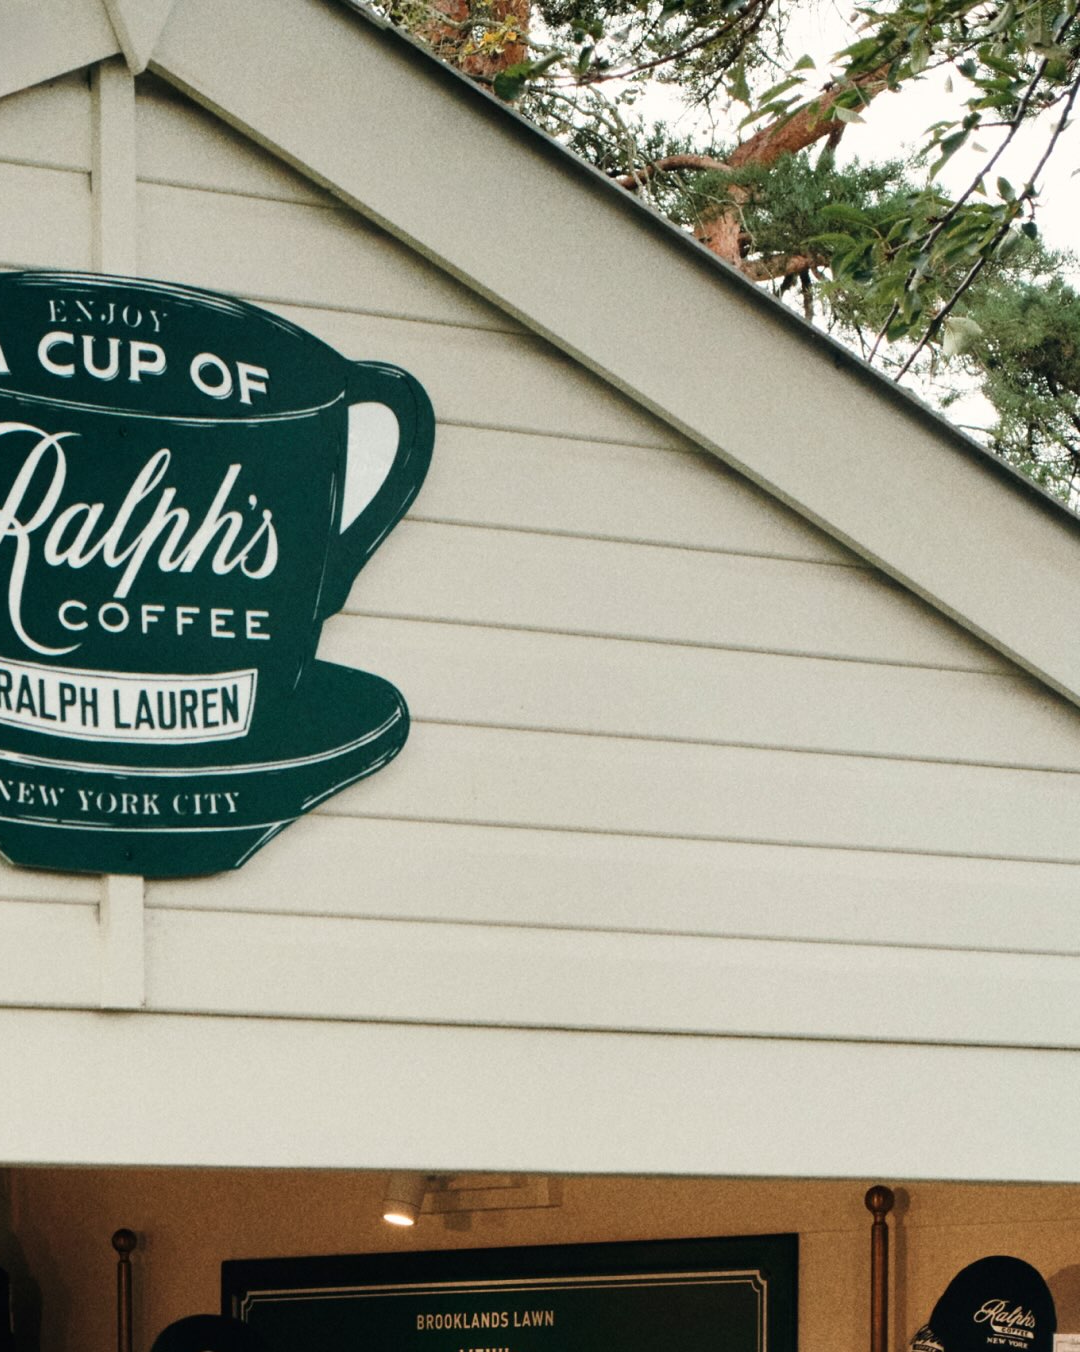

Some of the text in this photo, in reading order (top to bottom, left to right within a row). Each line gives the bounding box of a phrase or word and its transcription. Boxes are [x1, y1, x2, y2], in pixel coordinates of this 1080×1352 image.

[48, 299, 168, 334] ENJOY
[38, 331, 168, 382] CUP
[190, 350, 271, 406] OF
[58, 600, 272, 641] COFFEE
[113, 683, 240, 732] LAUREN
[78, 787, 160, 815] YORK
[172, 791, 241, 815] CITY
[416, 1310, 555, 1330] BROOKLANDS LAWN
[973, 1298, 1036, 1329] Ralph's
[986, 1337, 1029, 1349] NEW YORK
[1001, 1326, 1030, 1337] COFFEE
